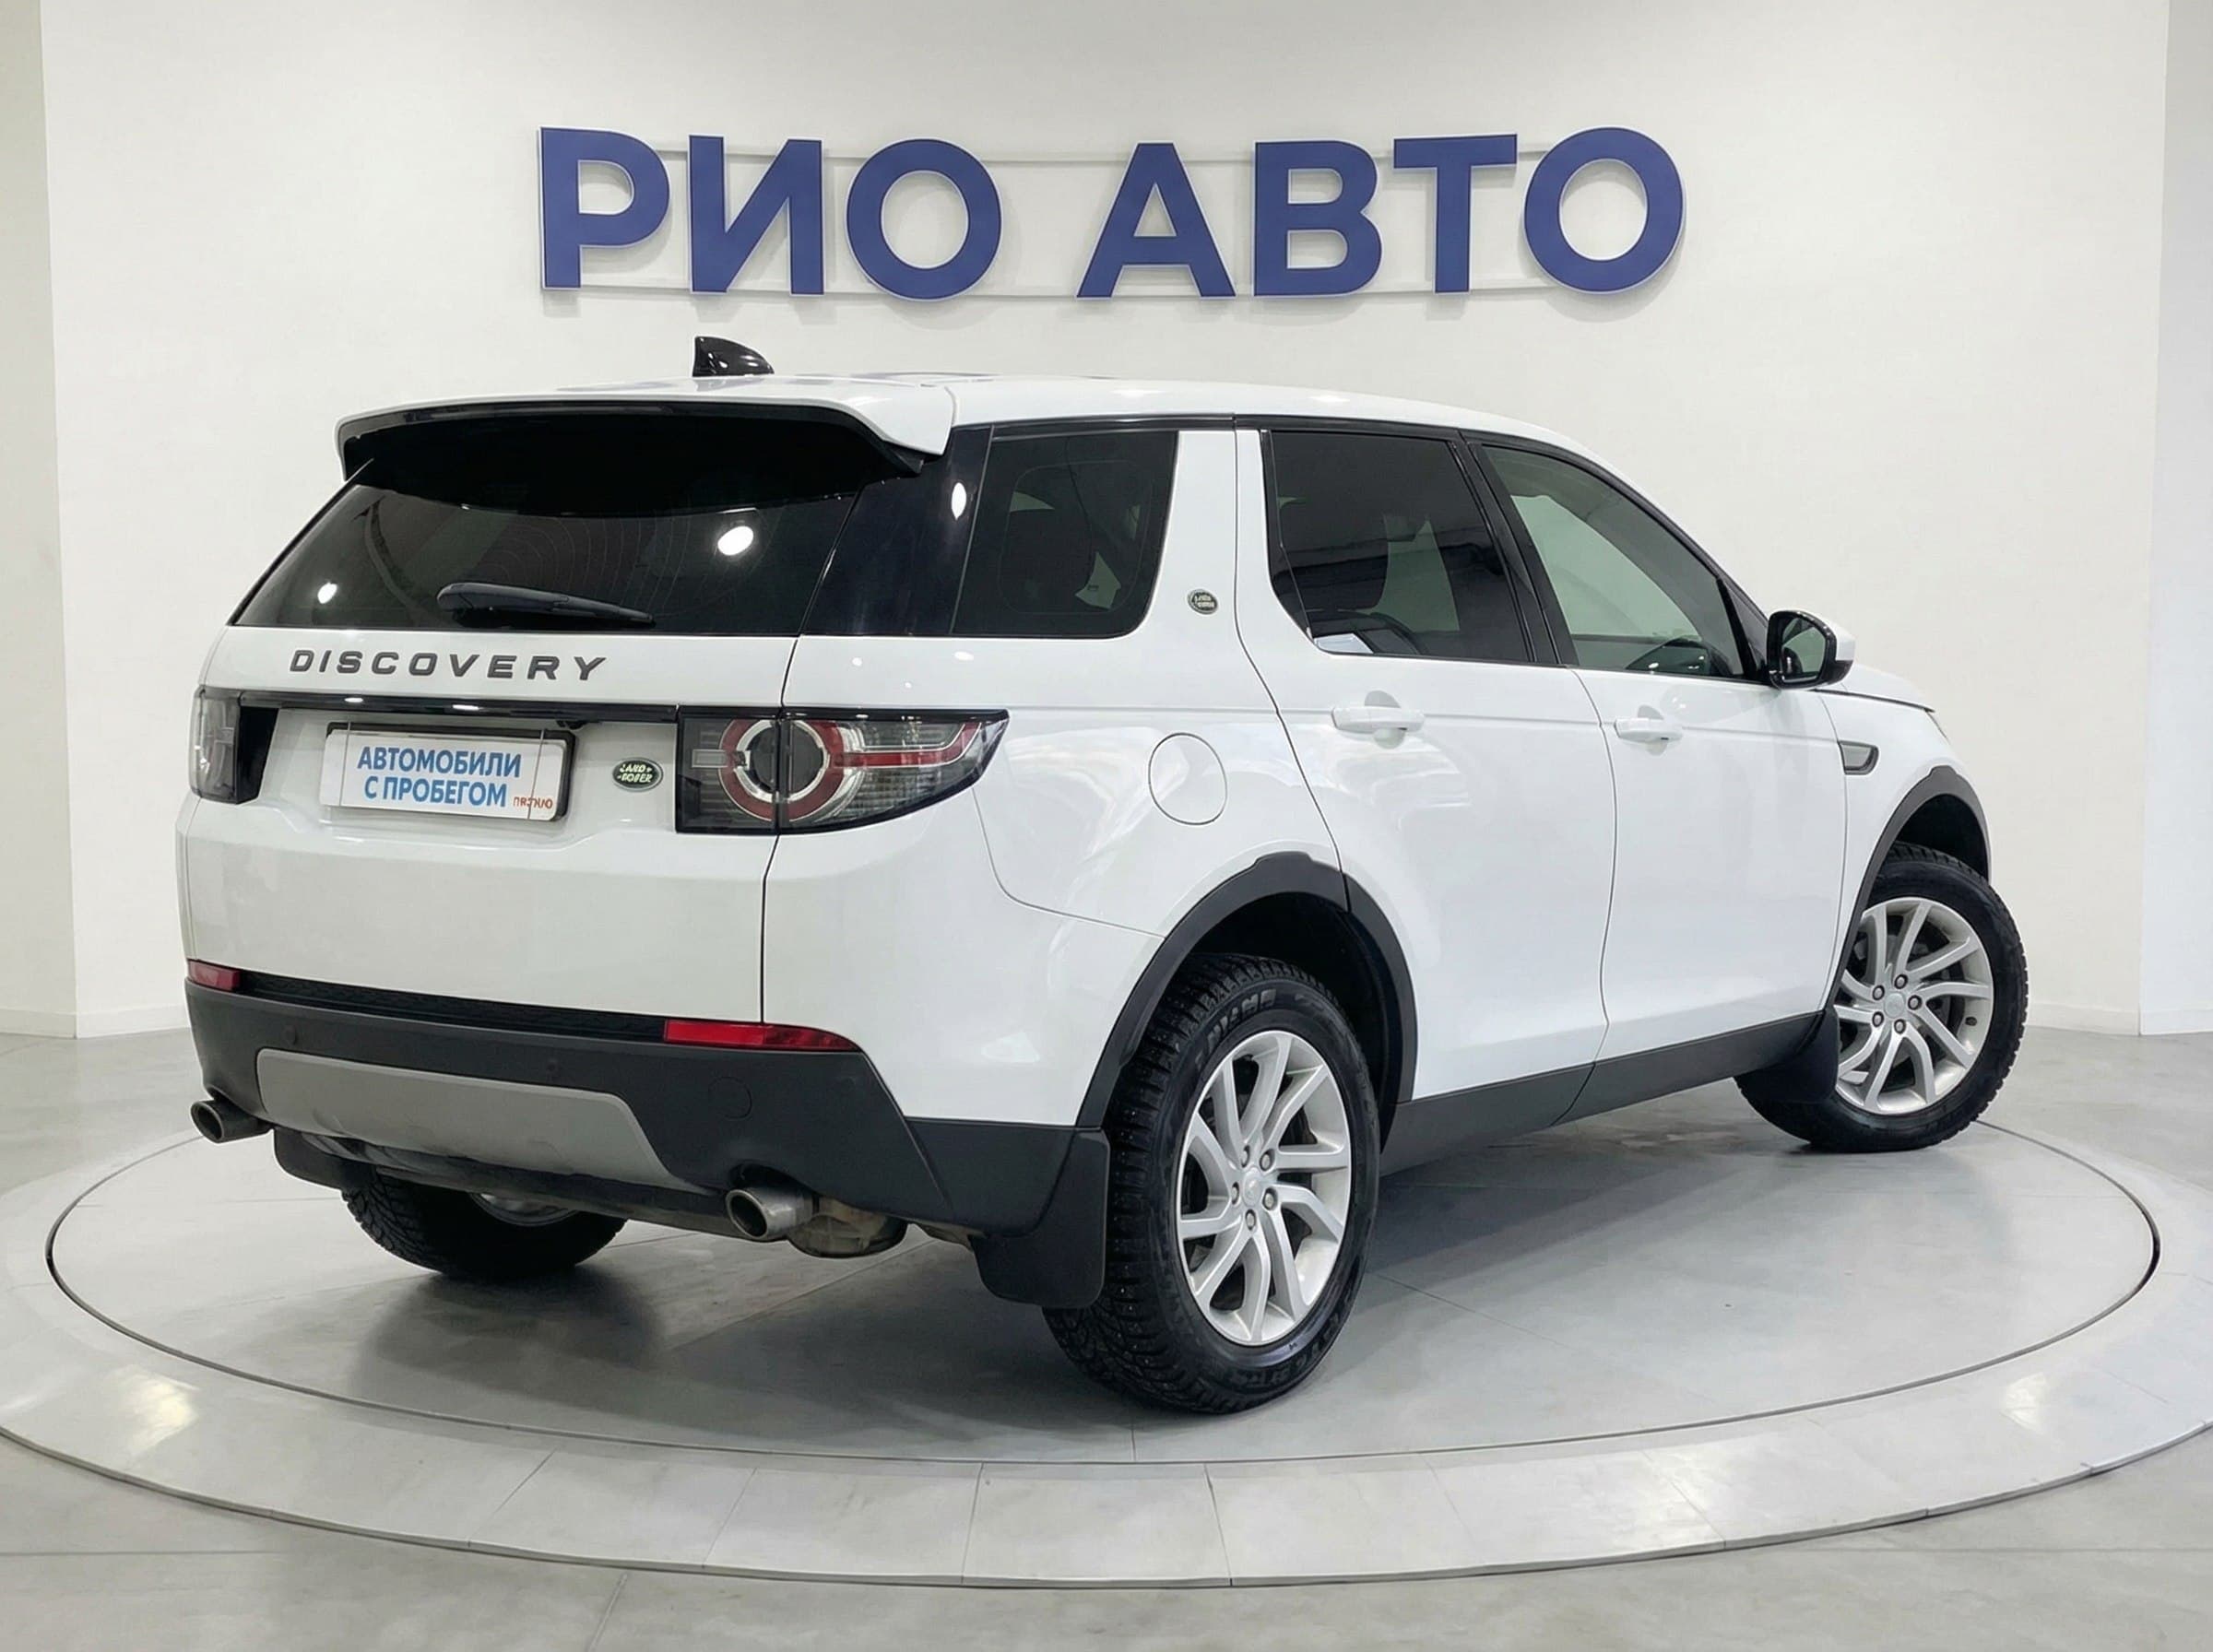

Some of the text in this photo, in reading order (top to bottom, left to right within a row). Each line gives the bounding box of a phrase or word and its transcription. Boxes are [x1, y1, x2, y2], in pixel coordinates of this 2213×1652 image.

[538, 126, 1685, 300] РИО АВТО
[290, 649, 608, 681] DISCOVERY
[357, 746, 522, 778] АВТОМОБИЛИ
[364, 775, 379, 799] С
[383, 776, 506, 808] ПРОБЕГОМ
